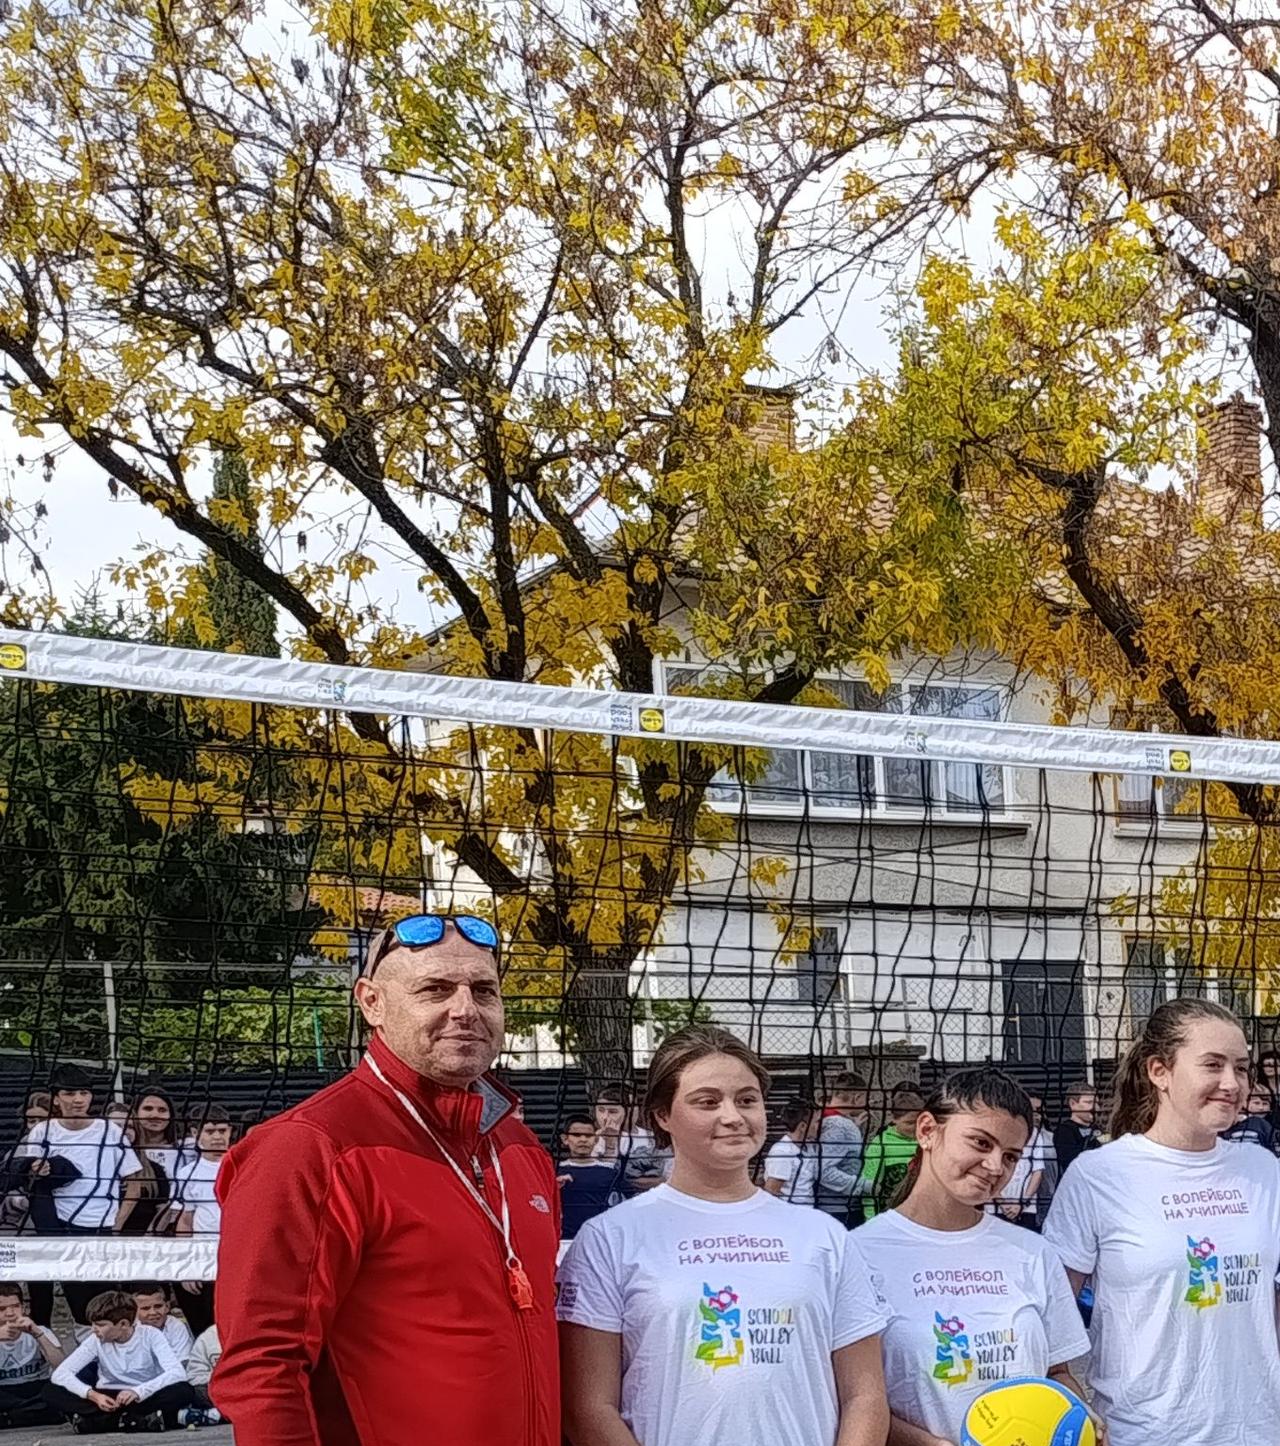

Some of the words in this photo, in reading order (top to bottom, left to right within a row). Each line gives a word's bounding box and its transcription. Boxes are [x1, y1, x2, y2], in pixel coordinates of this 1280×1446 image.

[1162, 1196, 1170, 1205] С
[1172, 1188, 1242, 1204] ВОЛЕЙБОЛ
[1164, 1210, 1184, 1220] НА
[1186, 1202, 1250, 1218] УЧИЛИЩЕ
[678, 1240, 688, 1250] С
[692, 1234, 784, 1250] ВОЛЕЙБОЛ
[678, 1254, 704, 1265] НА
[707, 1251, 791, 1264] УЧИЛИЩЕ
[913, 1272, 922, 1283] С
[926, 1268, 1004, 1282] ВОЛЕЙБОЛ
[914, 1287, 936, 1297] НА
[938, 1284, 1009, 1296] УЧИЛИЩЕ
[748, 1308, 795, 1325] SCHOOL
[974, 1328, 1018, 1348] SCHOOL
